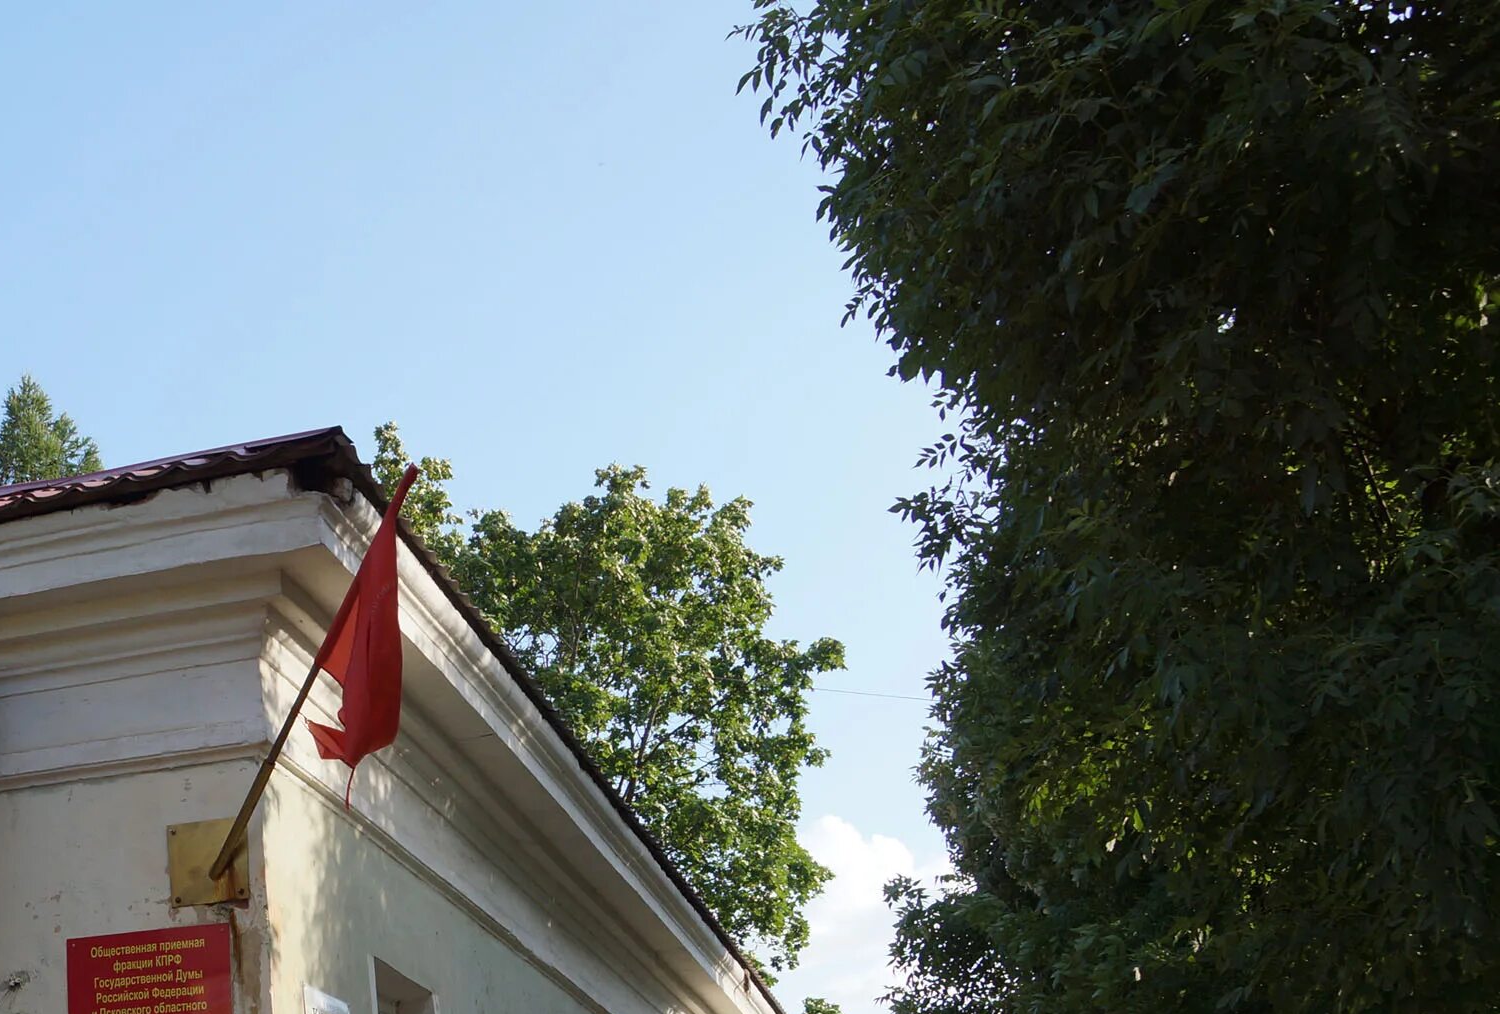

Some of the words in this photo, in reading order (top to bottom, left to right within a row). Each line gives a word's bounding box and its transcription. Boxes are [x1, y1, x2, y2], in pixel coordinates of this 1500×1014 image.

[90, 943, 157, 958] Общественная
[159, 938, 205, 950] приемная
[113, 958, 153, 973] фракции
[156, 954, 182, 967] КПРФ
[94, 970, 173, 989] Государственной
[176, 969, 203, 983] Думы
[96, 988, 150, 1004] Российской
[152, 985, 204, 999] Федерации
[154, 1001, 207, 1014] областного
